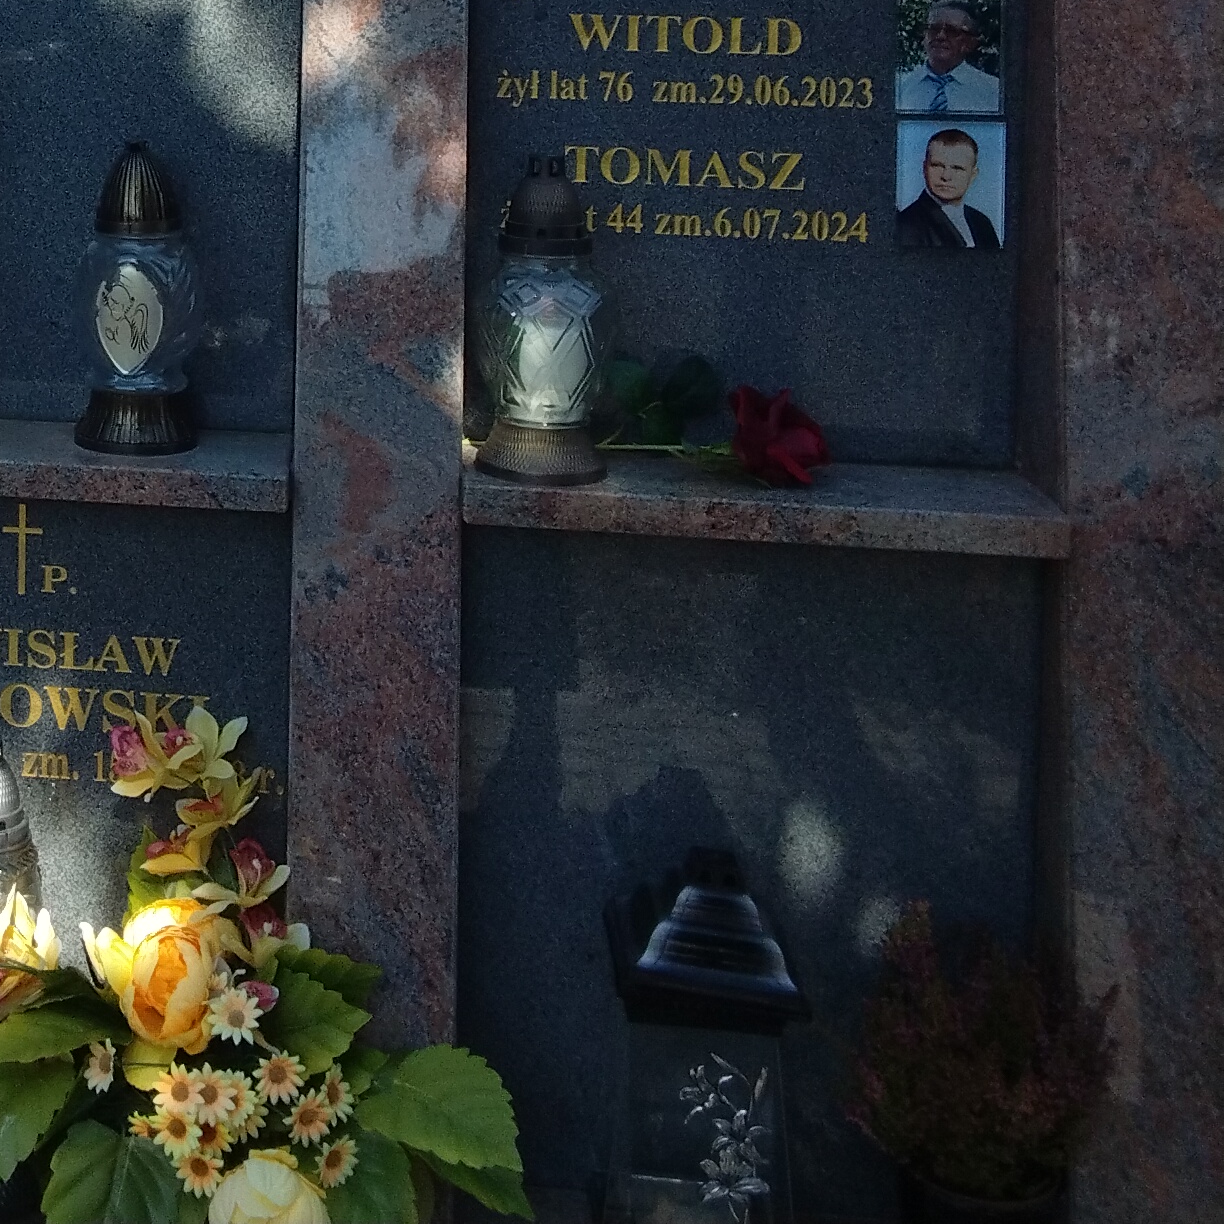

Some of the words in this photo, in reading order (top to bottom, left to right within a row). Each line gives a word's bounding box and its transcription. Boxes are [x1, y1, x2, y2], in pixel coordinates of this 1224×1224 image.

[569, 13, 803, 56] WITOLD
[496, 70, 540, 107] żył
[549, 70, 589, 101] lat
[599, 72, 634, 102] 76
[652, 75, 874, 109] zm.29.06.2023
[564, 145, 805, 190] TOMASZ
[607, 203, 643, 233] 44
[654, 206, 869, 243] zm.6.07.2024
[22, 751, 79, 781] zm.
